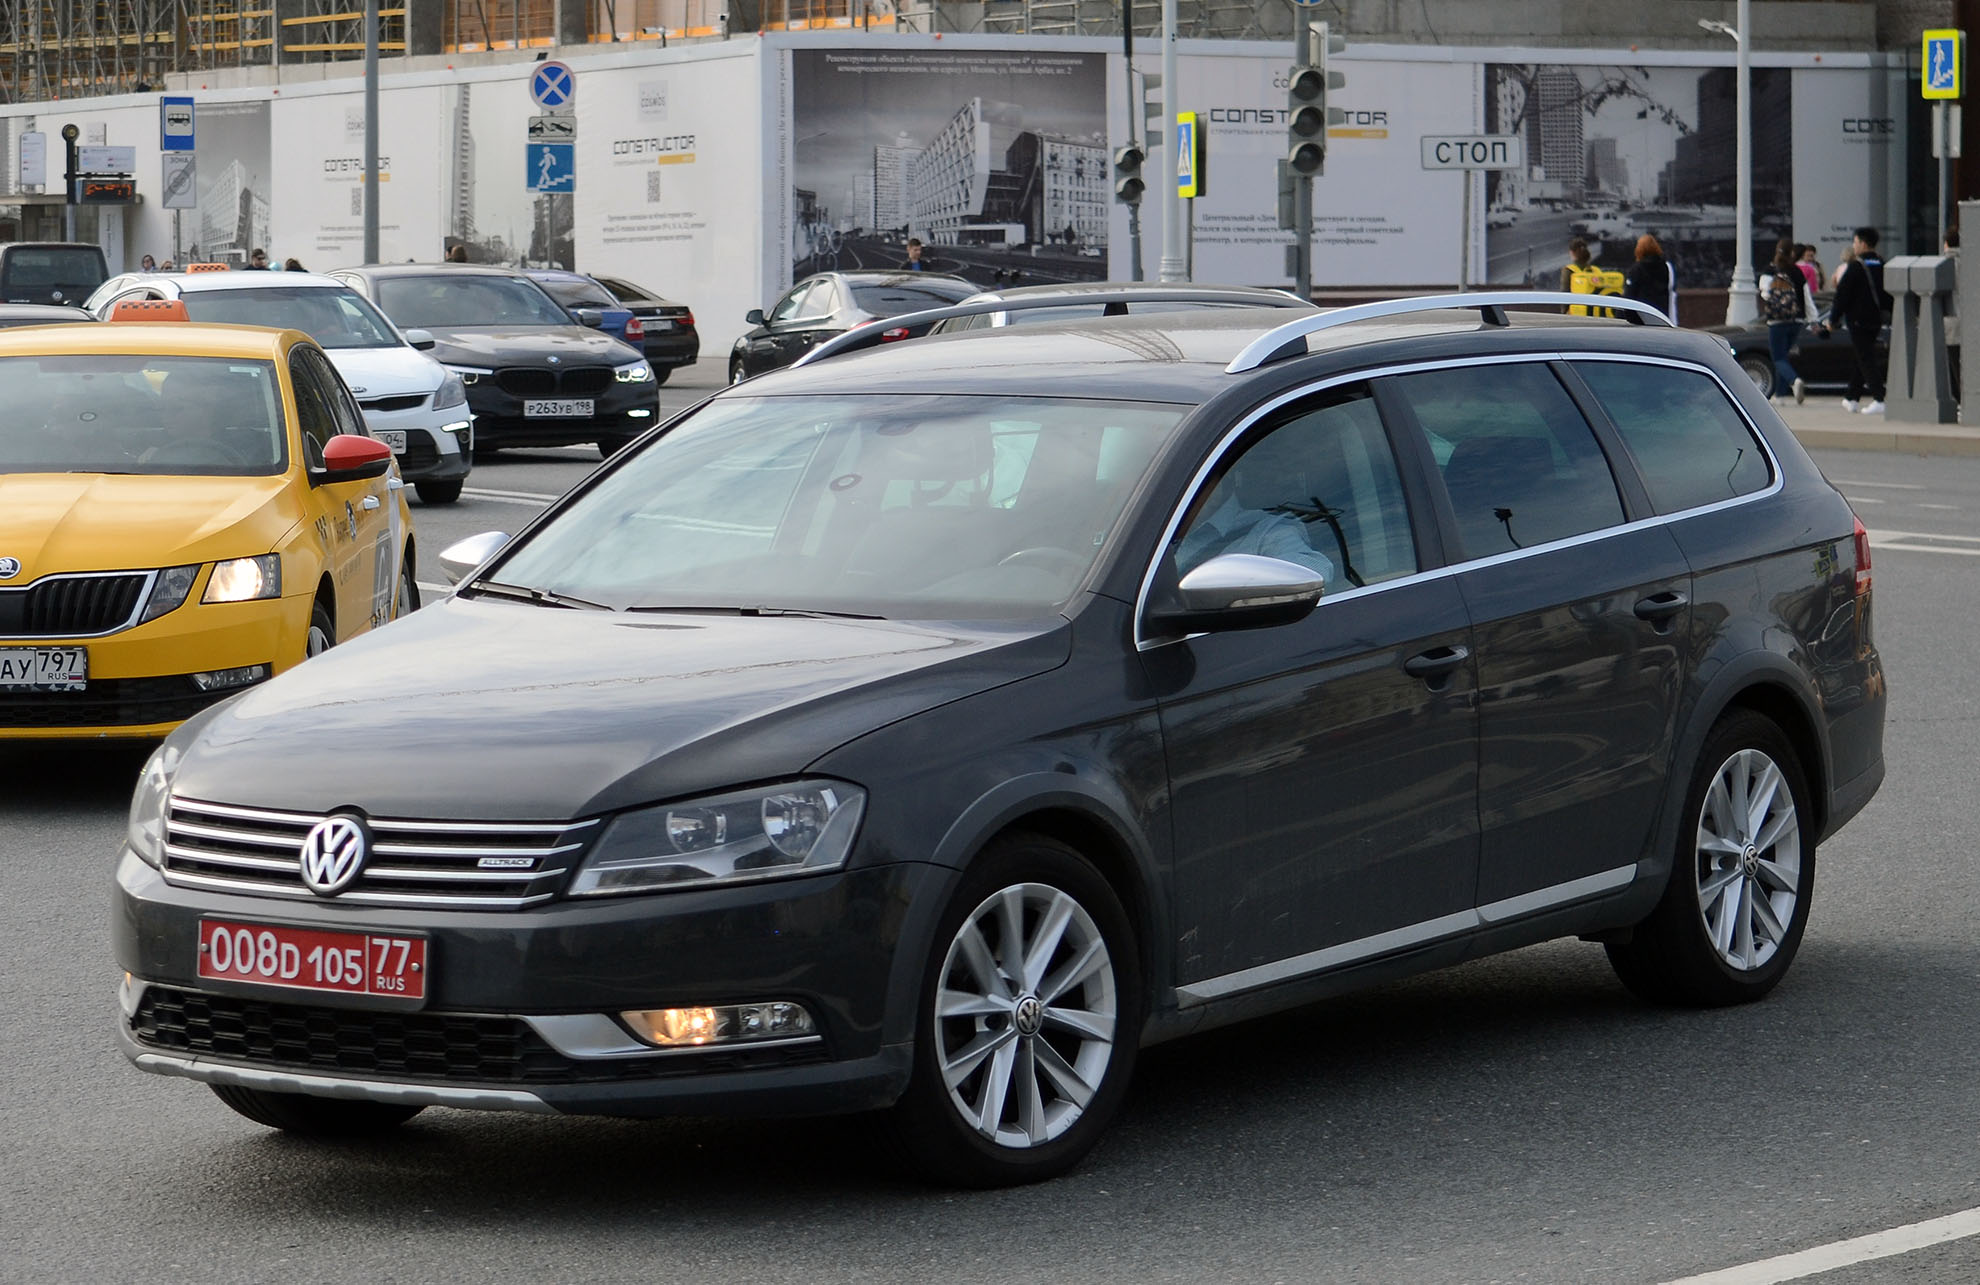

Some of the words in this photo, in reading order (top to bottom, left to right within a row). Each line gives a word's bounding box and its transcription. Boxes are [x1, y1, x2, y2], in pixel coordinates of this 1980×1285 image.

[614, 135, 696, 154] CONSTRUCTOR
[1436, 142, 1507, 163] СТОП
[575, 401, 592, 411] 198
[38, 652, 78, 672] 797
[48, 672, 68, 680] RUS
[371, 938, 411, 976] 77
[376, 976, 406, 991] RUS
